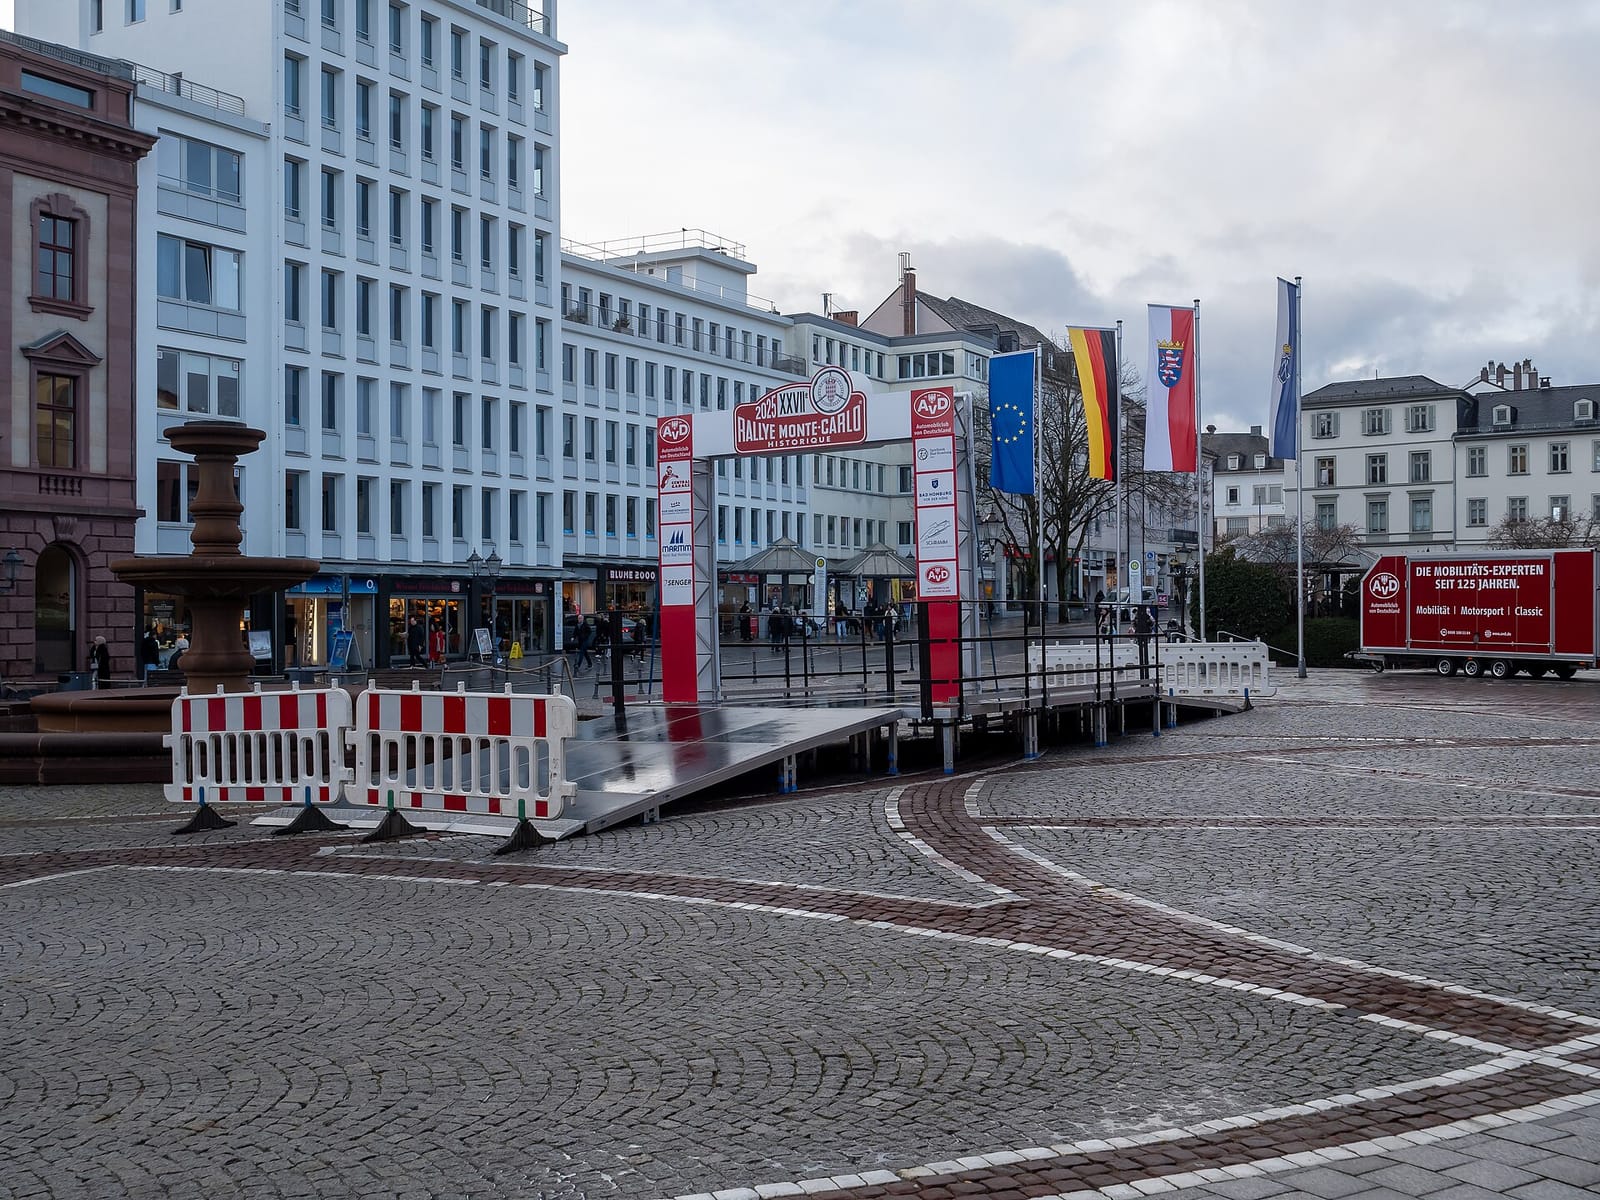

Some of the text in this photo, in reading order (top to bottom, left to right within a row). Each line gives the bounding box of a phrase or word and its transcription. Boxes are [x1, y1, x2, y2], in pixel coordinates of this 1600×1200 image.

[755, 395, 776, 420] 2025
[738, 404, 861, 442] RALLYE MONTE-CARLO
[768, 436, 831, 448] HISTORIQUE
[610, 570, 656, 580] BLUME 2000
[1415, 563, 1544, 577] DIE MOBILITÄTS-EXPERTEN
[1435, 578, 1520, 591] SEIT 125 JAHREN.
[1416, 605, 1543, 618] Mobilität Motorsport Classic
